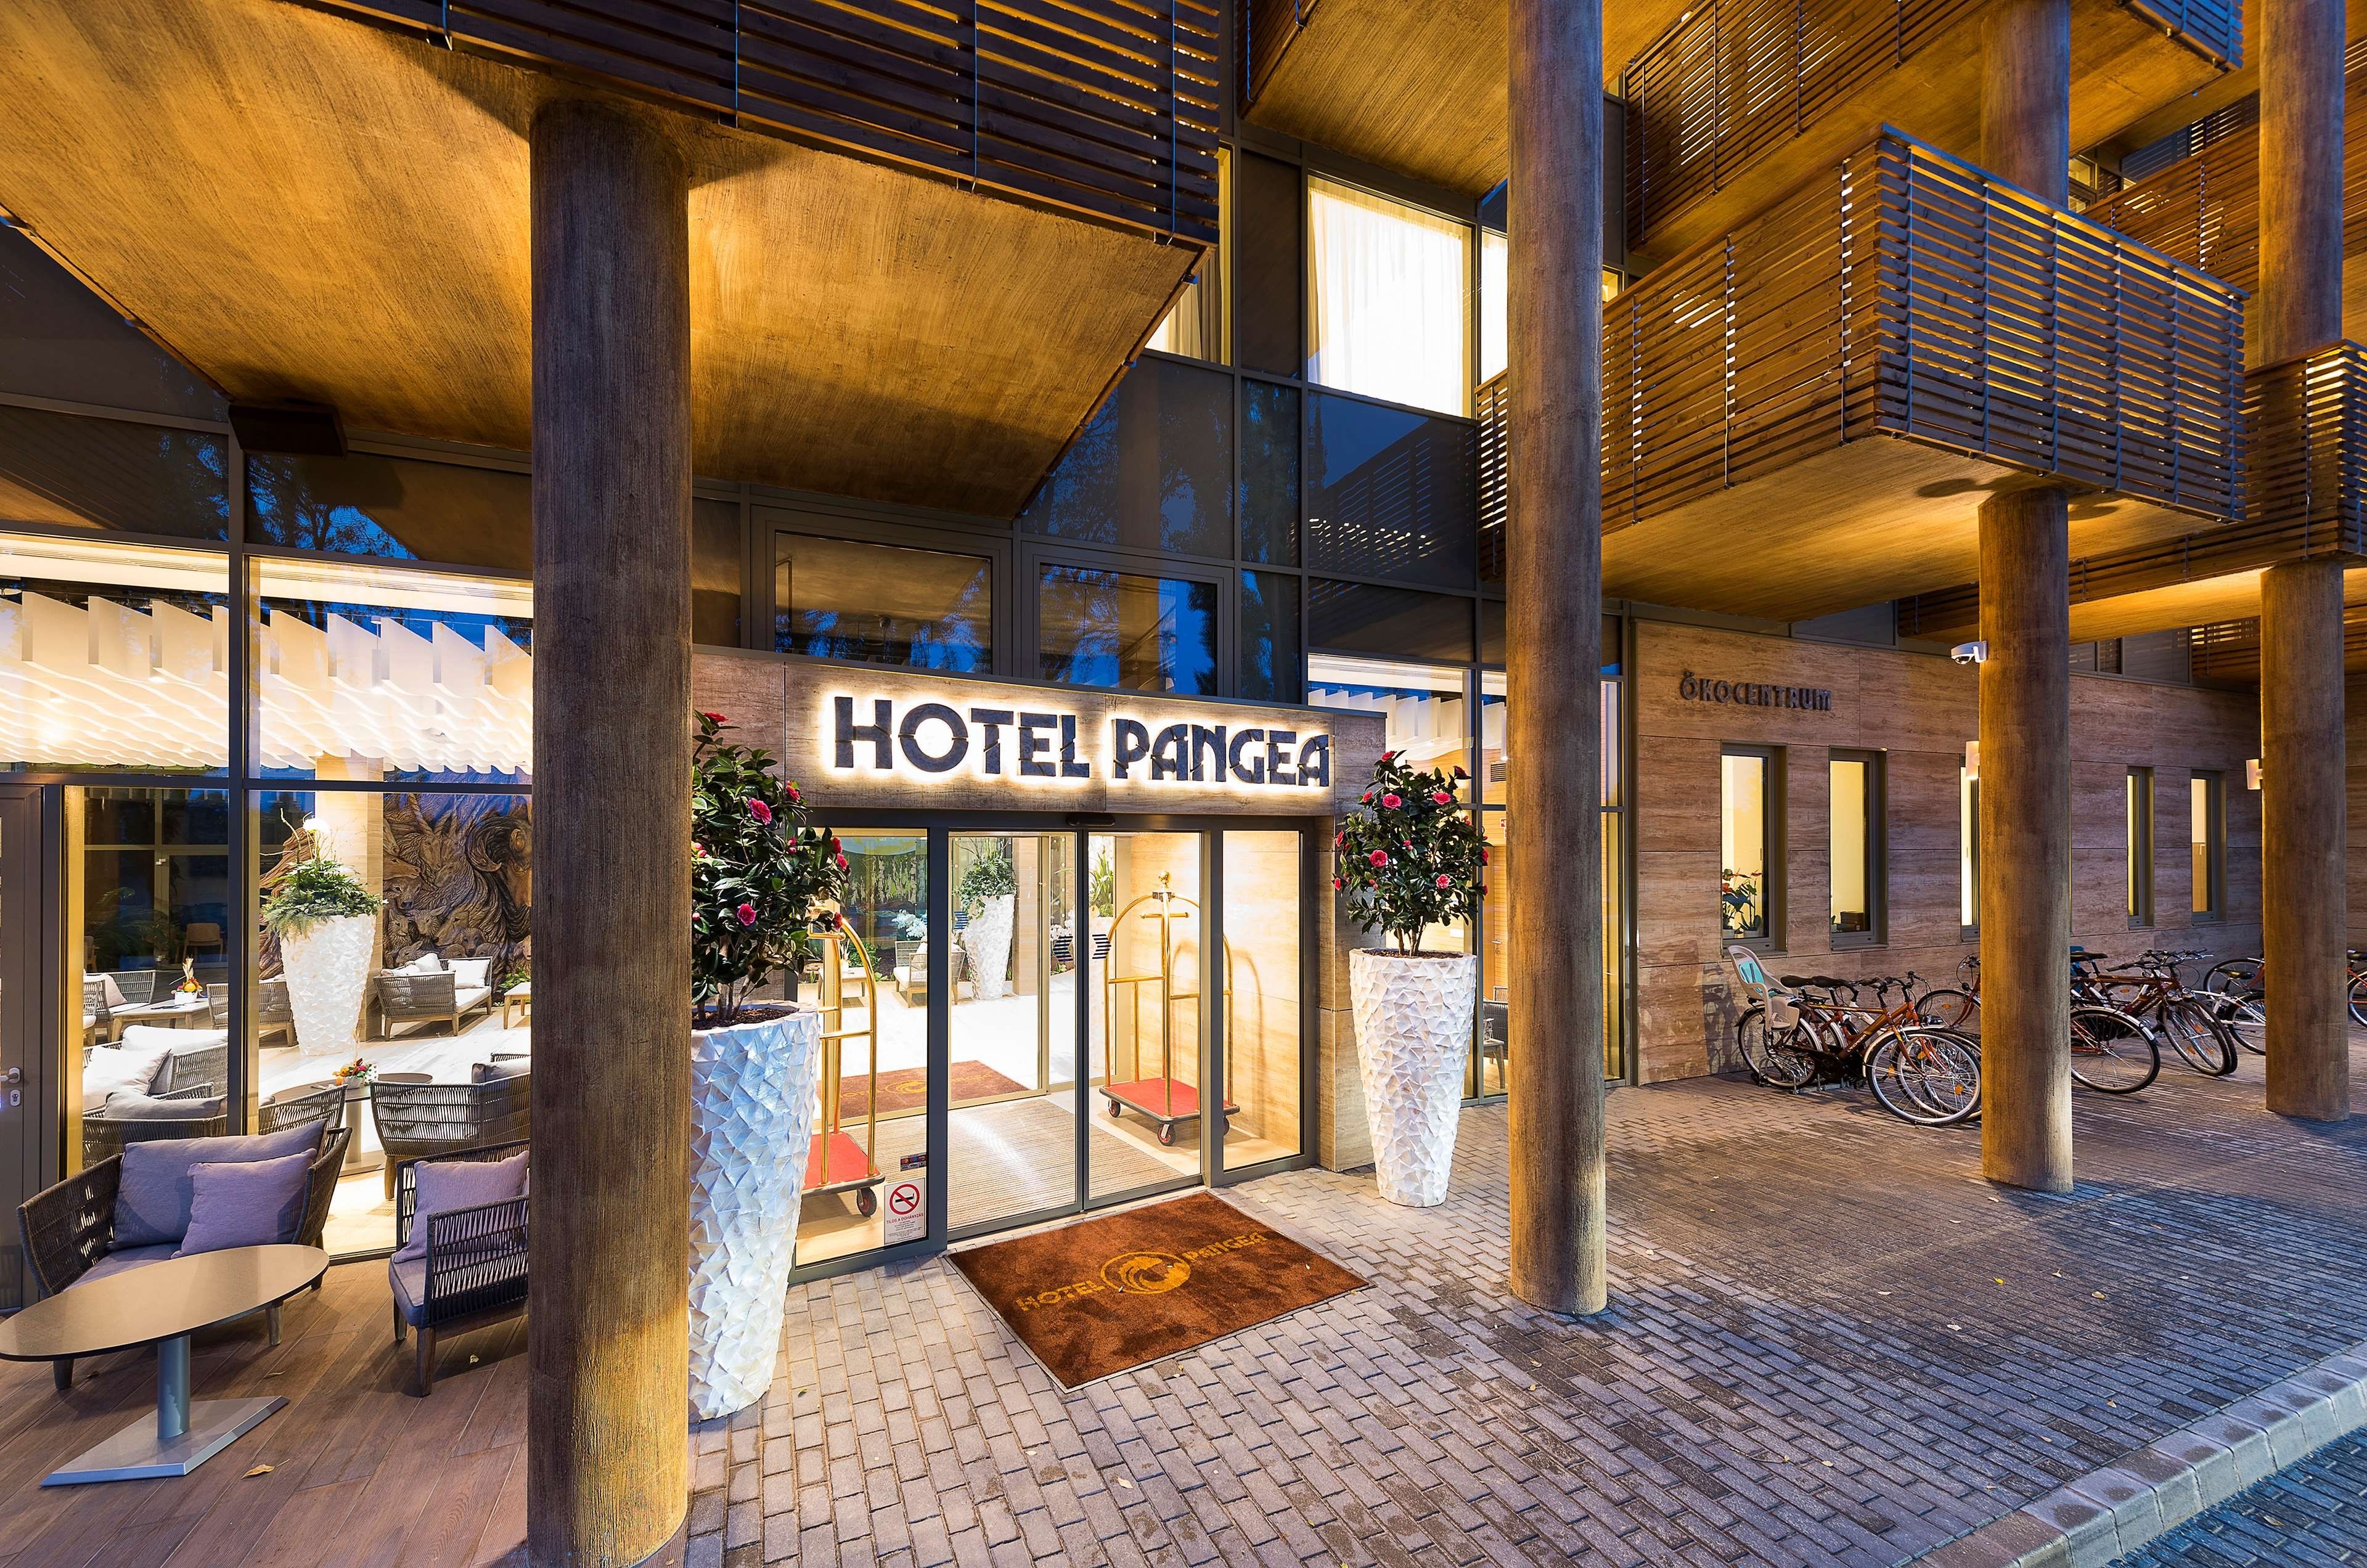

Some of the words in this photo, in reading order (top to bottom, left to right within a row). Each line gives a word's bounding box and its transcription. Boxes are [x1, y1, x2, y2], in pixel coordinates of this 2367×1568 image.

[1680, 669, 1832, 711] ÖKOCENTRUM
[834, 696, 1090, 778] HOTEL
[1112, 718, 1330, 788] PANGEA
[1016, 1280, 1105, 1312] HOTEL
[1182, 1232, 1268, 1263] PANGEA
